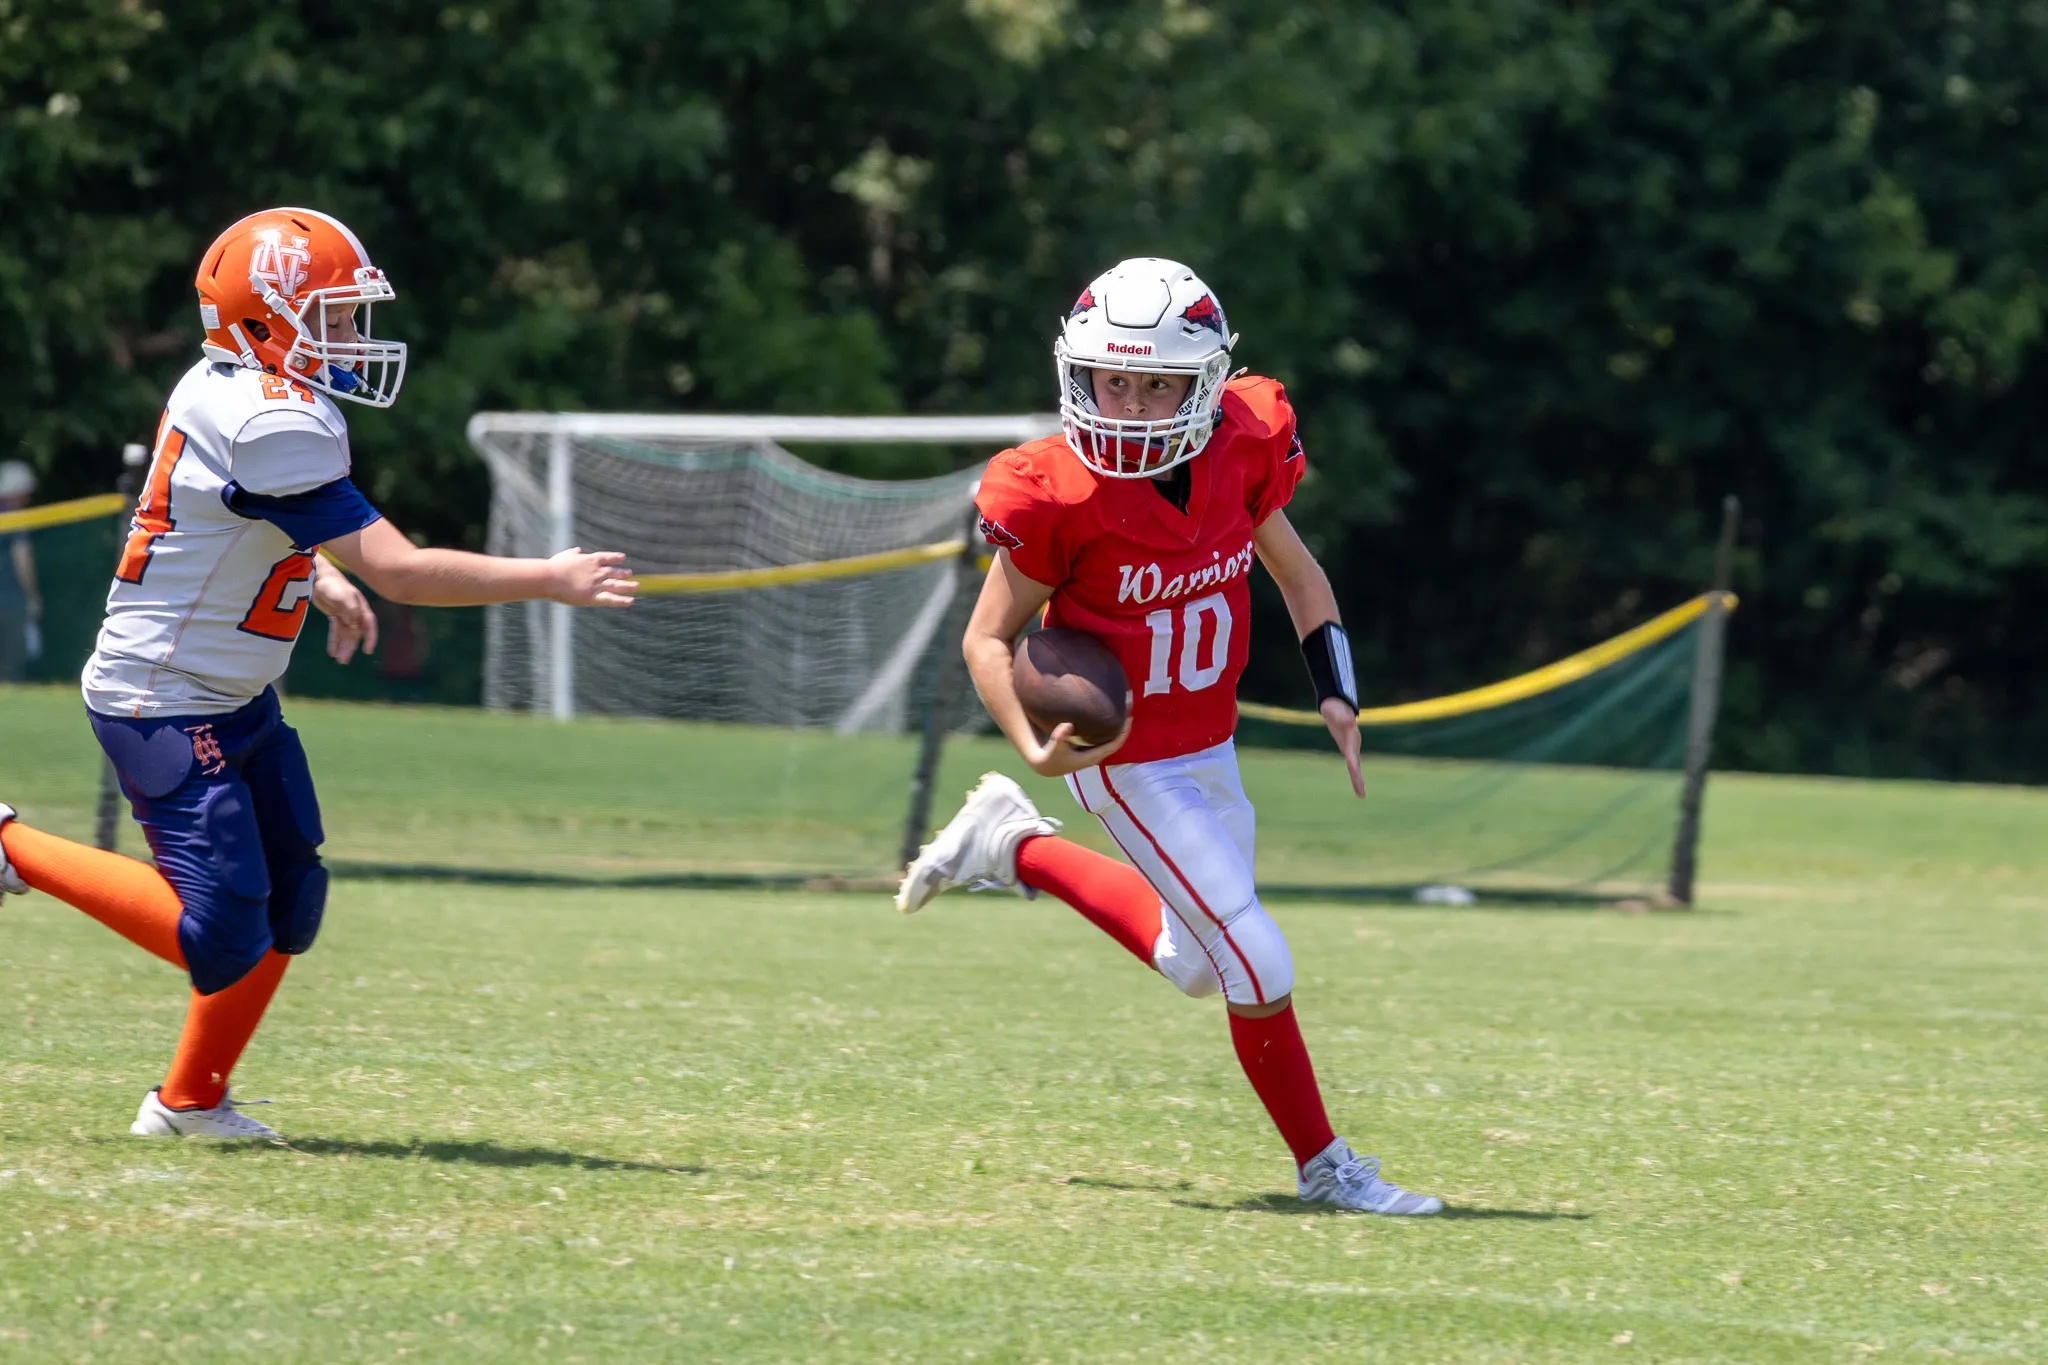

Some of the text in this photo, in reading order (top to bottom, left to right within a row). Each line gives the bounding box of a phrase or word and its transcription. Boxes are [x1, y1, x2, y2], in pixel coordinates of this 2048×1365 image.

[1107, 342, 1152, 355] Riddell
[1177, 388, 1210, 415] Ridell
[1118, 540, 1253, 604] Warriors
[1143, 591, 1233, 698] 10
